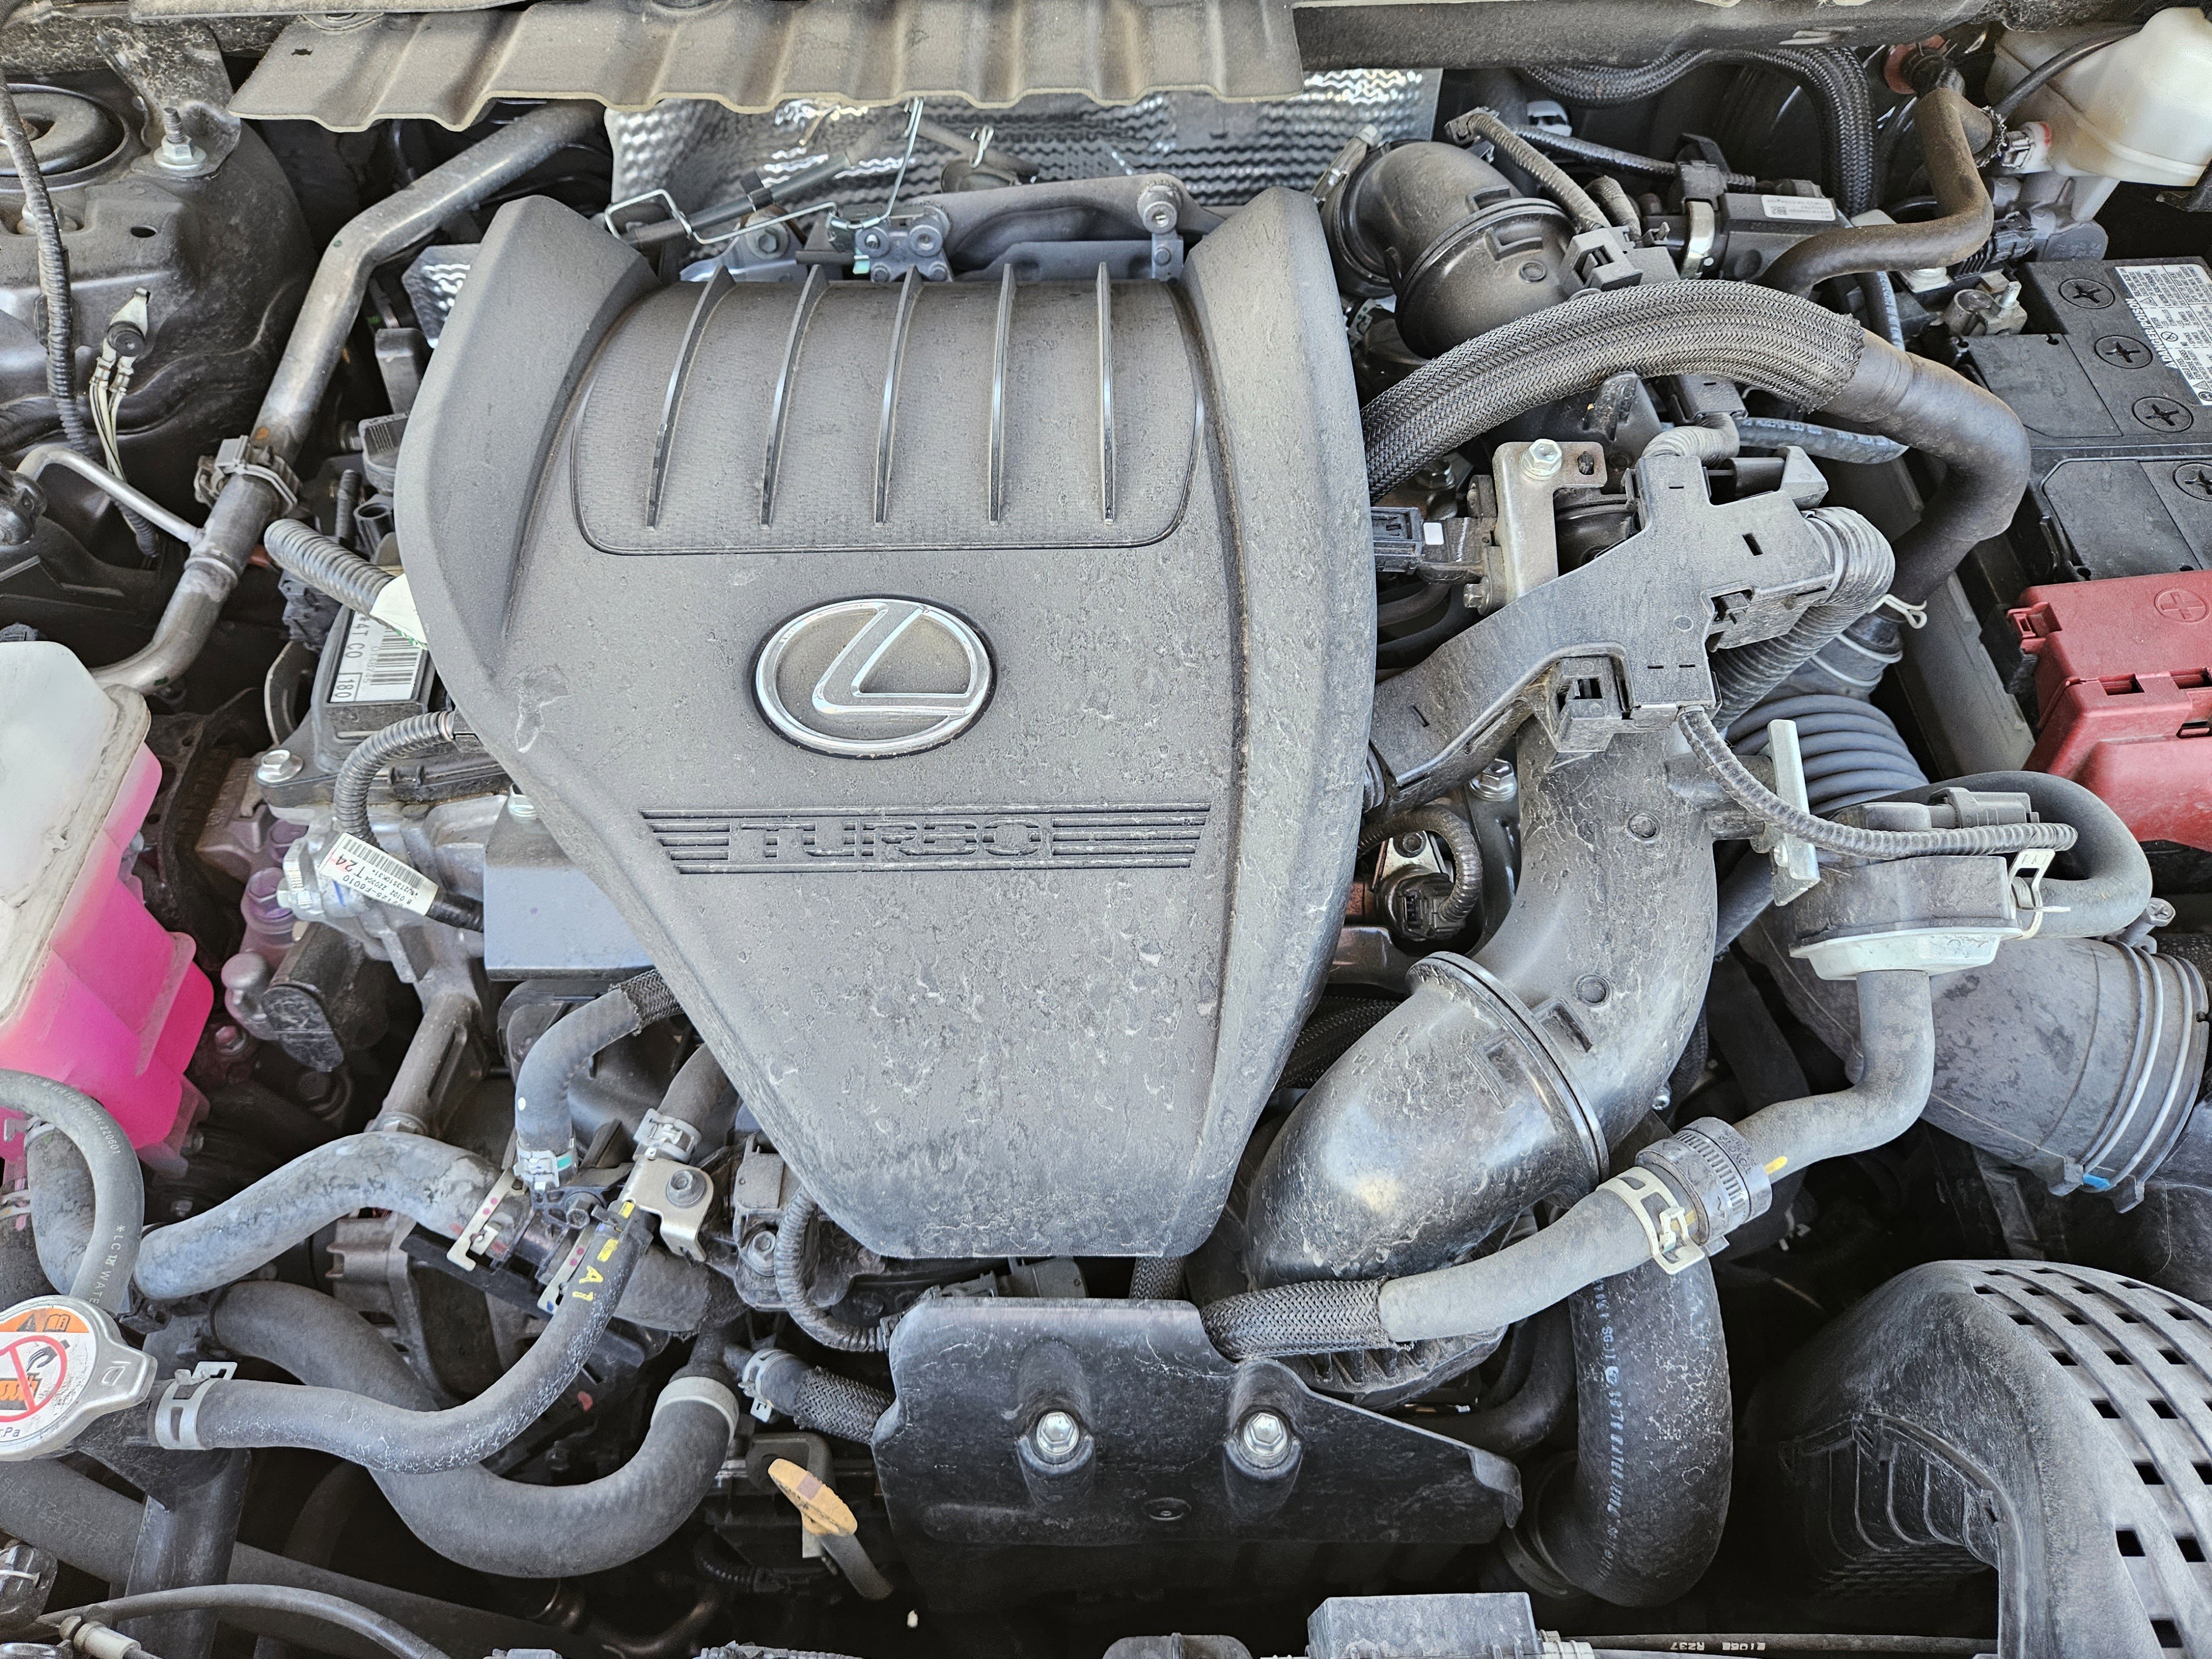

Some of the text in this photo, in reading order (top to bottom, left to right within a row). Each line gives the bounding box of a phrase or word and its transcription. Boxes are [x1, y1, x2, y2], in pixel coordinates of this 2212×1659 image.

[2124, 298, 2174, 361] DANGER/POISON
[334, 678, 355, 698] 180
[740, 820, 1042, 858] TURBO
